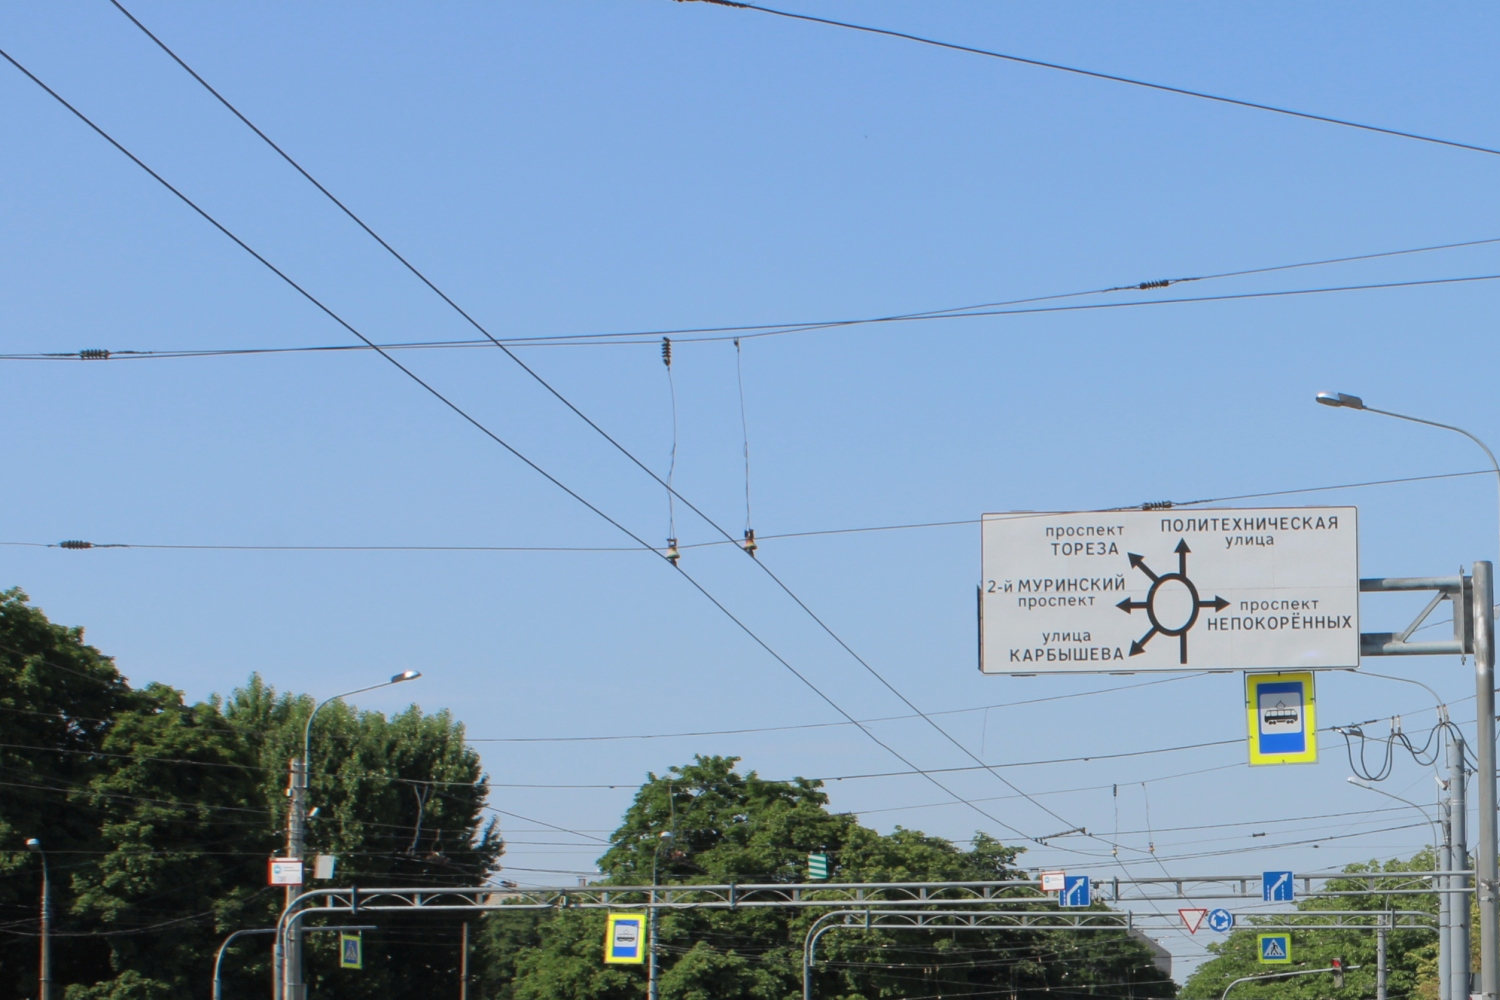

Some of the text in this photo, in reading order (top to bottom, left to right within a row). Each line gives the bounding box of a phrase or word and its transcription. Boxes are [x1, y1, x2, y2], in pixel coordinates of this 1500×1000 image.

[1045, 525, 1125, 539] проспект
[1160, 516, 1339, 533] ПОЛИТЕХНИЧЕСКАЯ
[1051, 542, 1119, 556] ТОРЕЗА
[1225, 535, 1275, 549] улица
[987, 574, 1126, 594] 2-й МУРИНСКИЙ
[1018, 596, 1096, 611] проспект
[1240, 599, 1319, 613] проспект
[1207, 612, 1352, 631] НЕПОКОРЁННЫХ
[1042, 631, 1092, 646] улица
[1010, 647, 1124, 663] КАРБЫШЕВА
